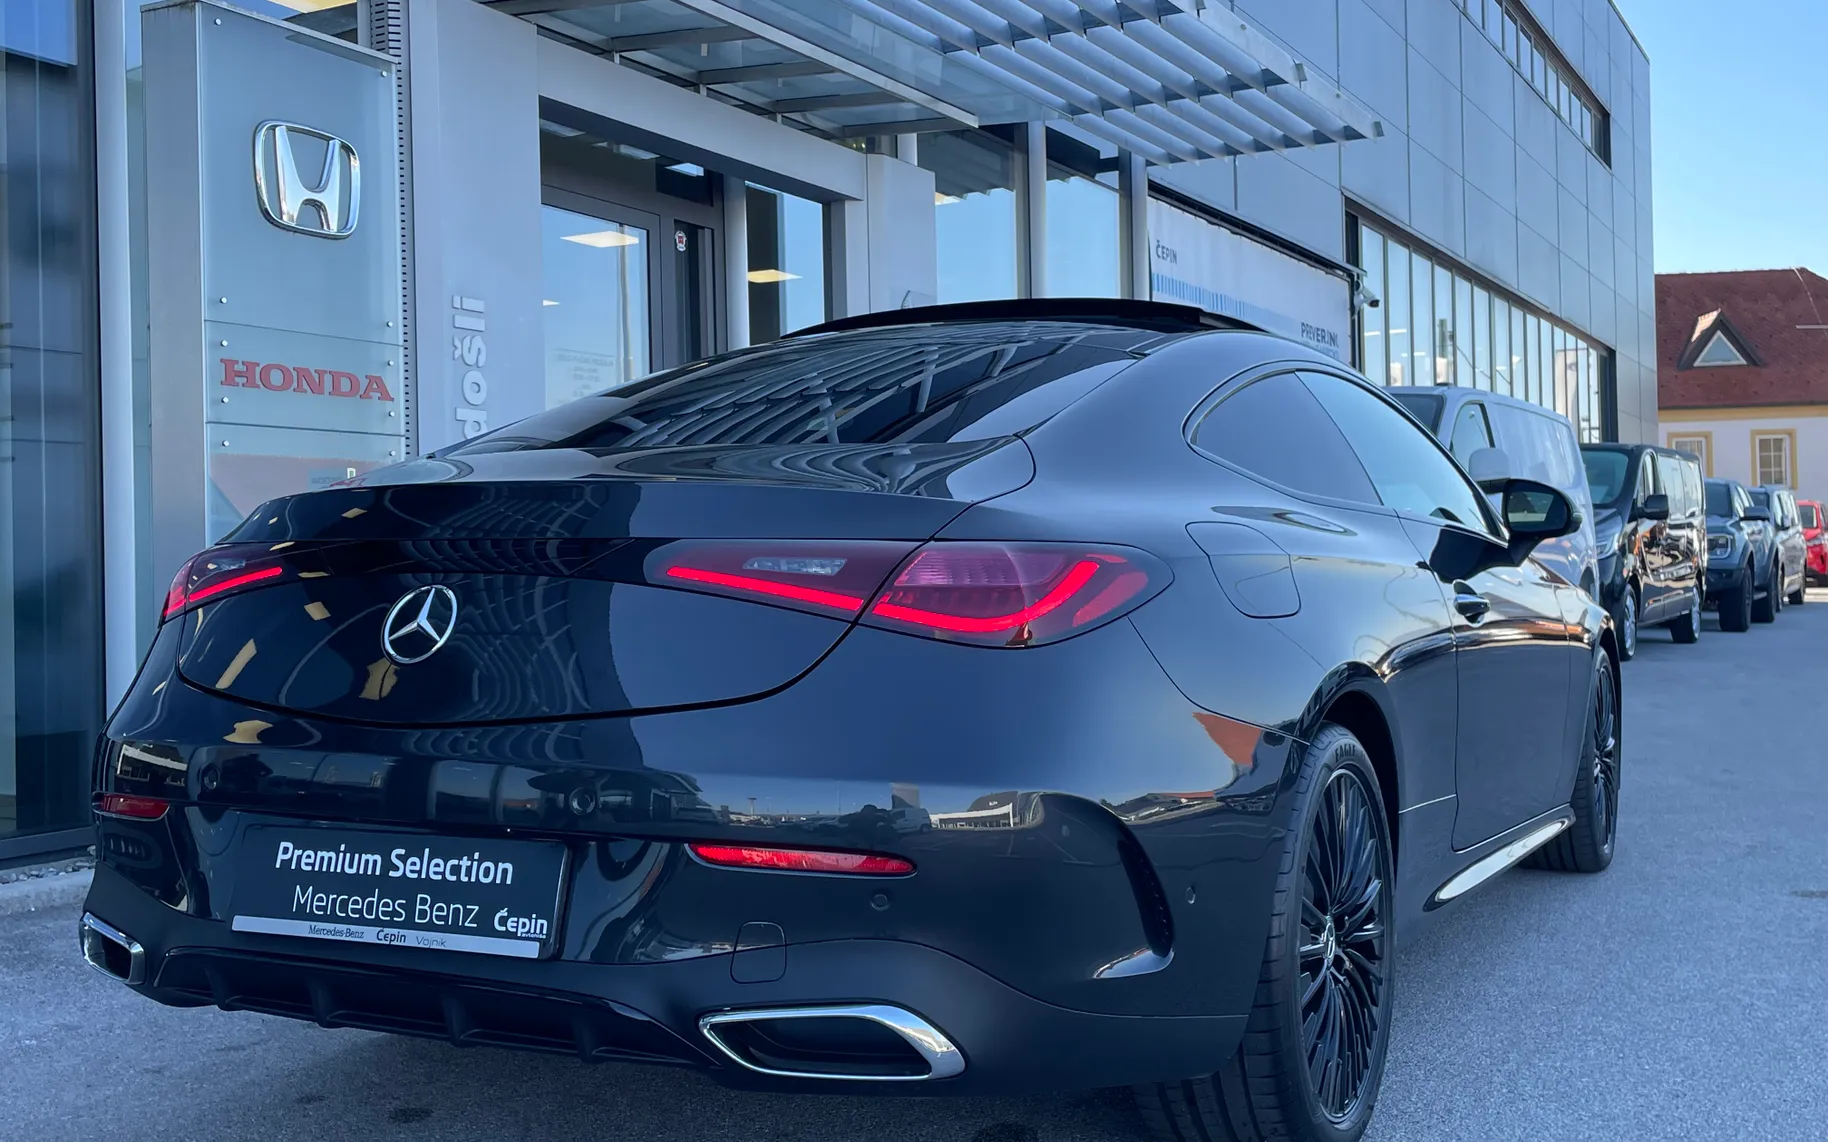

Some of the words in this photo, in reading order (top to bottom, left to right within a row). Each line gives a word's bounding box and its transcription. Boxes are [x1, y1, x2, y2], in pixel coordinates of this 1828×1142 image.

[1155, 239, 1178, 265] ČEPIN
[220, 358, 395, 402] HONDA
[1335, 743, 1356, 763] EAGLE
[275, 841, 382, 876] Premium
[388, 848, 514, 885] Selection
[292, 884, 406, 921] Mercedes
[414, 893, 480, 927] Benz
[308, 924, 365, 940] Mercedes-Benz
[376, 927, 407, 945] Čepin
[416, 936, 447, 949] Vojnik
[493, 907, 548, 937] Čepin
